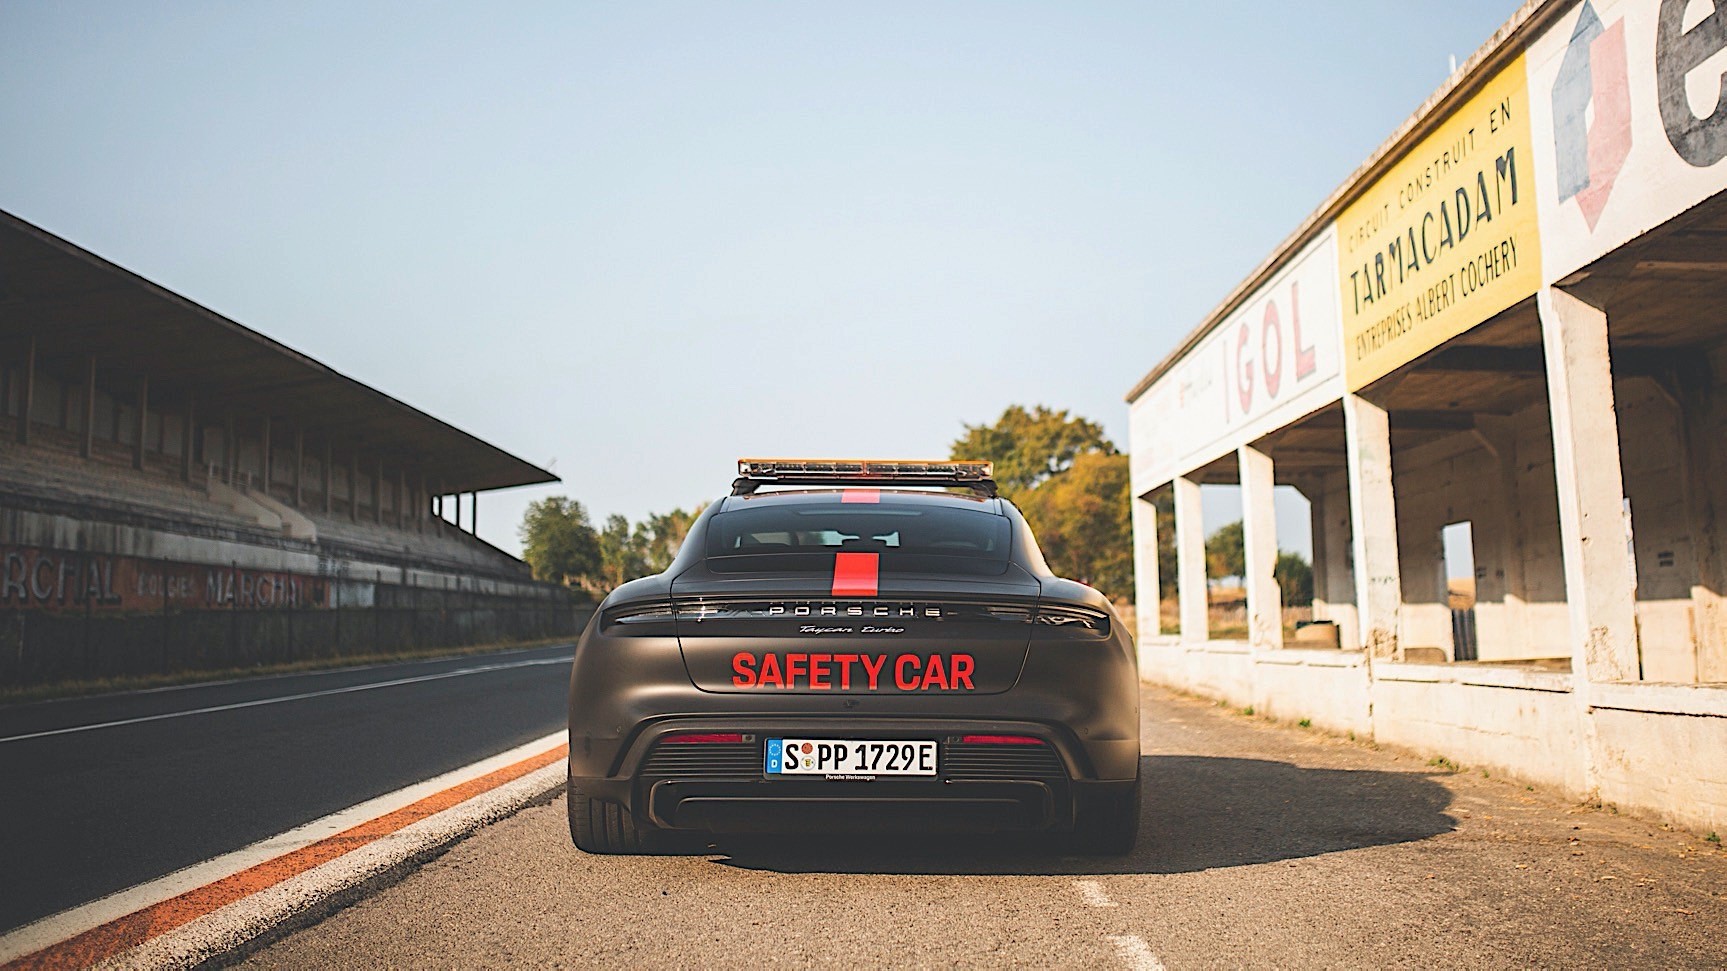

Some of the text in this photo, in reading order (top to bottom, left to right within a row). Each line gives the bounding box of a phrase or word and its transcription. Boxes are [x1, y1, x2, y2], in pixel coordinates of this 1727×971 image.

[1350, 97, 1511, 251] CIRCUIT CONSTRUIT EN
[1350, 146, 1518, 315] TARMACADAM
[1356, 233, 1518, 361] ENTREPRISES ALBERT COCHERY
[769, 606, 940, 617] PORSCHE
[800, 625, 852, 635] Taycan
[732, 652, 975, 691] SAFETY CAR
[784, 743, 933, 771] S PP 1729E
